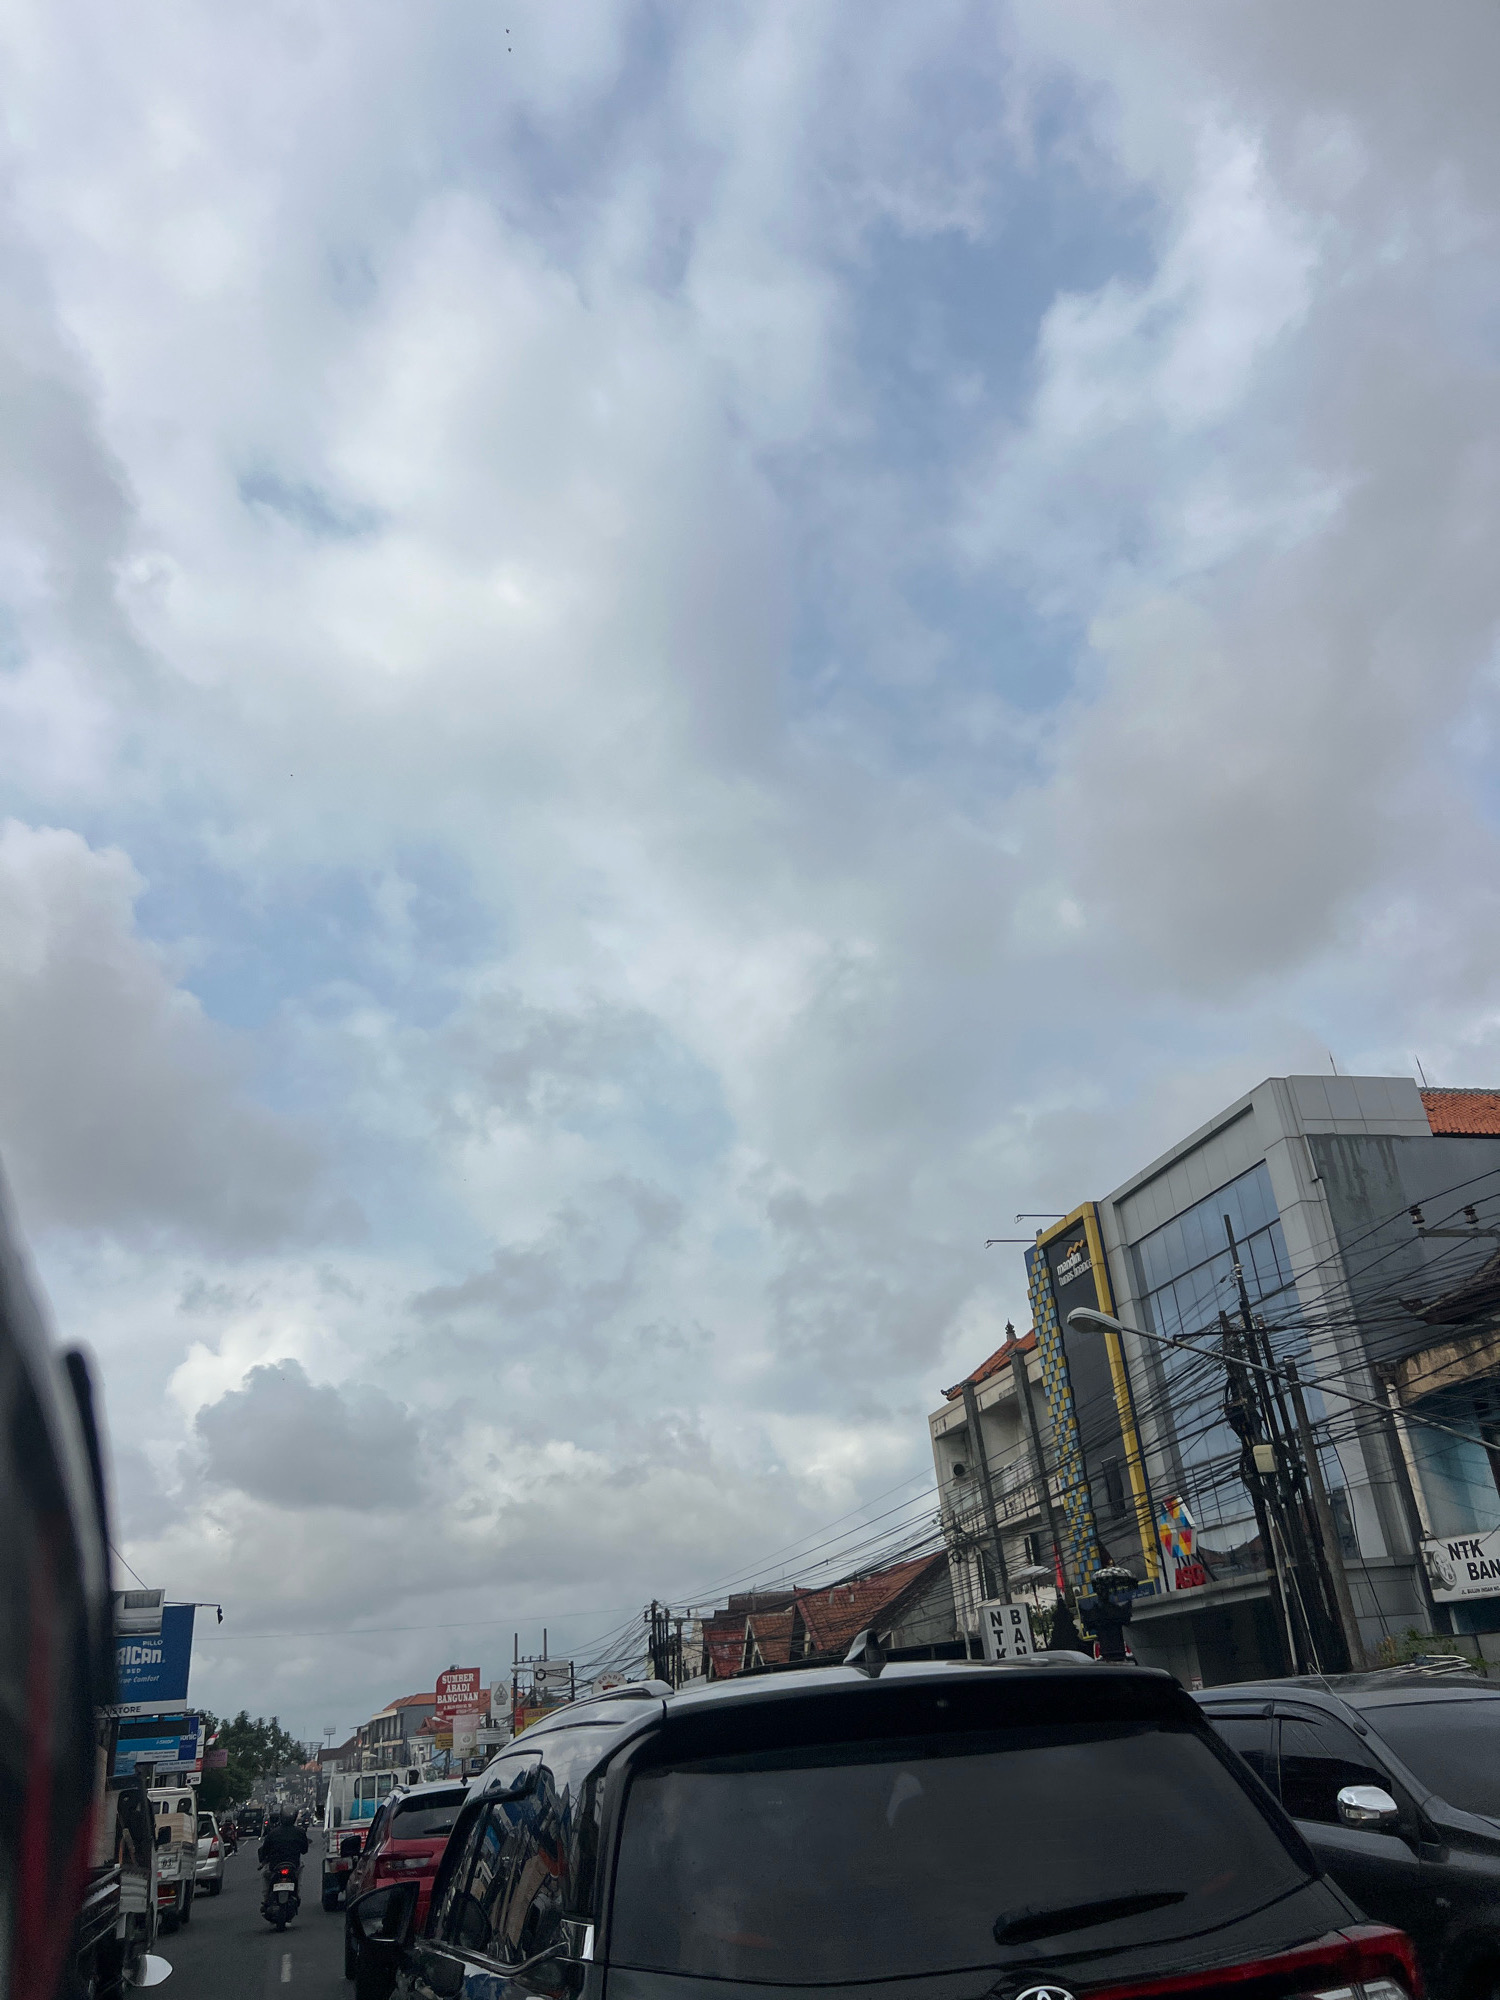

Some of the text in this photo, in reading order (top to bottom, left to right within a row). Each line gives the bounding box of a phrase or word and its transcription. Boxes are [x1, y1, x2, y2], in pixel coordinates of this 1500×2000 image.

[1057, 1252, 1082, 1275] mandiri
[1447, 1539, 1484, 1561] NTK
[442, 1673, 474, 1684] SUMBER
[446, 1683, 470, 1693] ABADI
[437, 1692, 479, 1704] BANGUNAN
